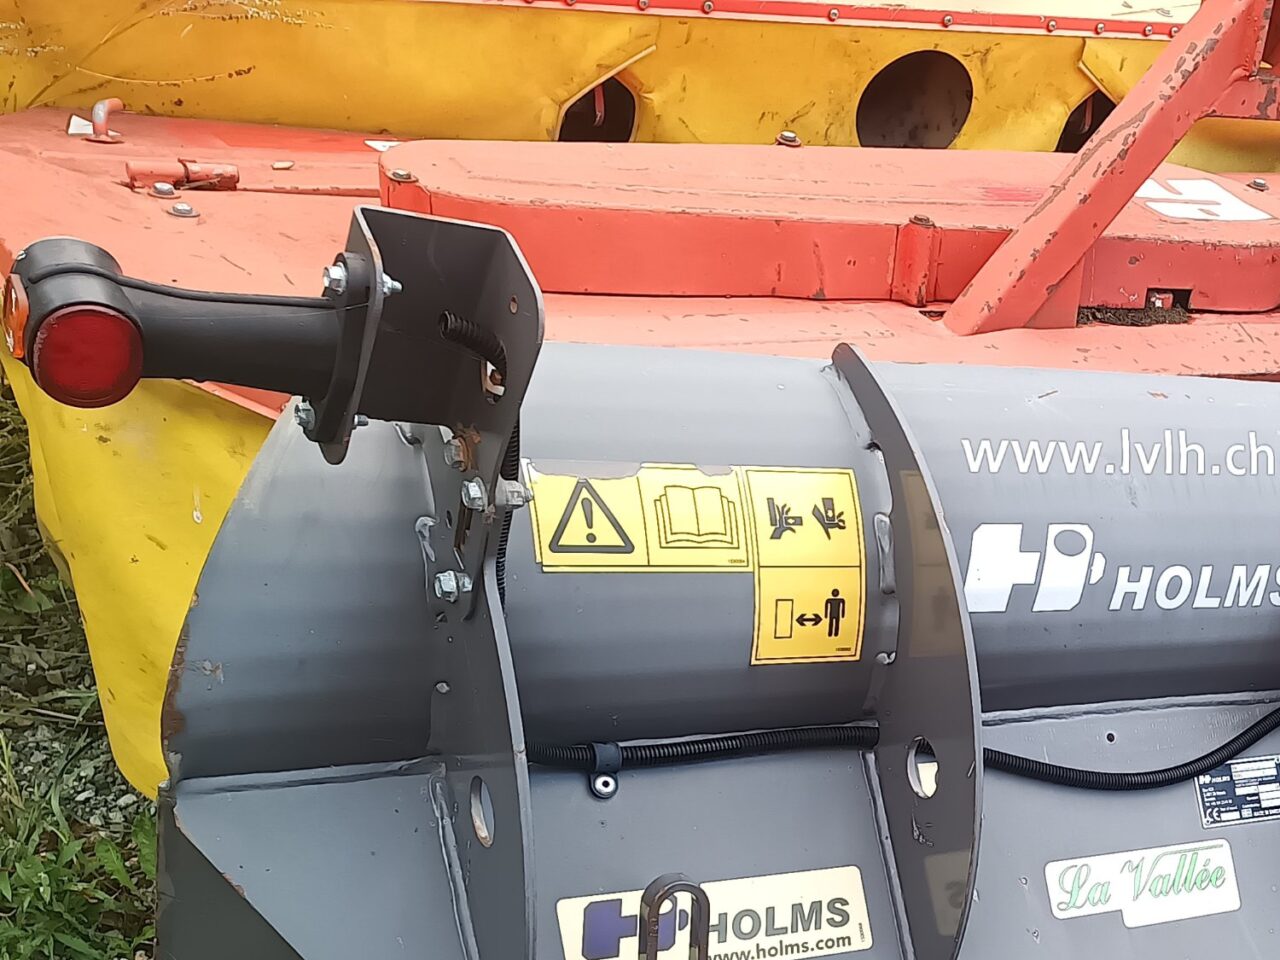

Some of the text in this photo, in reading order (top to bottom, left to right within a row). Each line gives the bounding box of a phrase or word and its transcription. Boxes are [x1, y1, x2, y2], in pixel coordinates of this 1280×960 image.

[961, 428, 1275, 475] www.lvlh.ch
[1057, 844, 1225, 911] La Vallée
